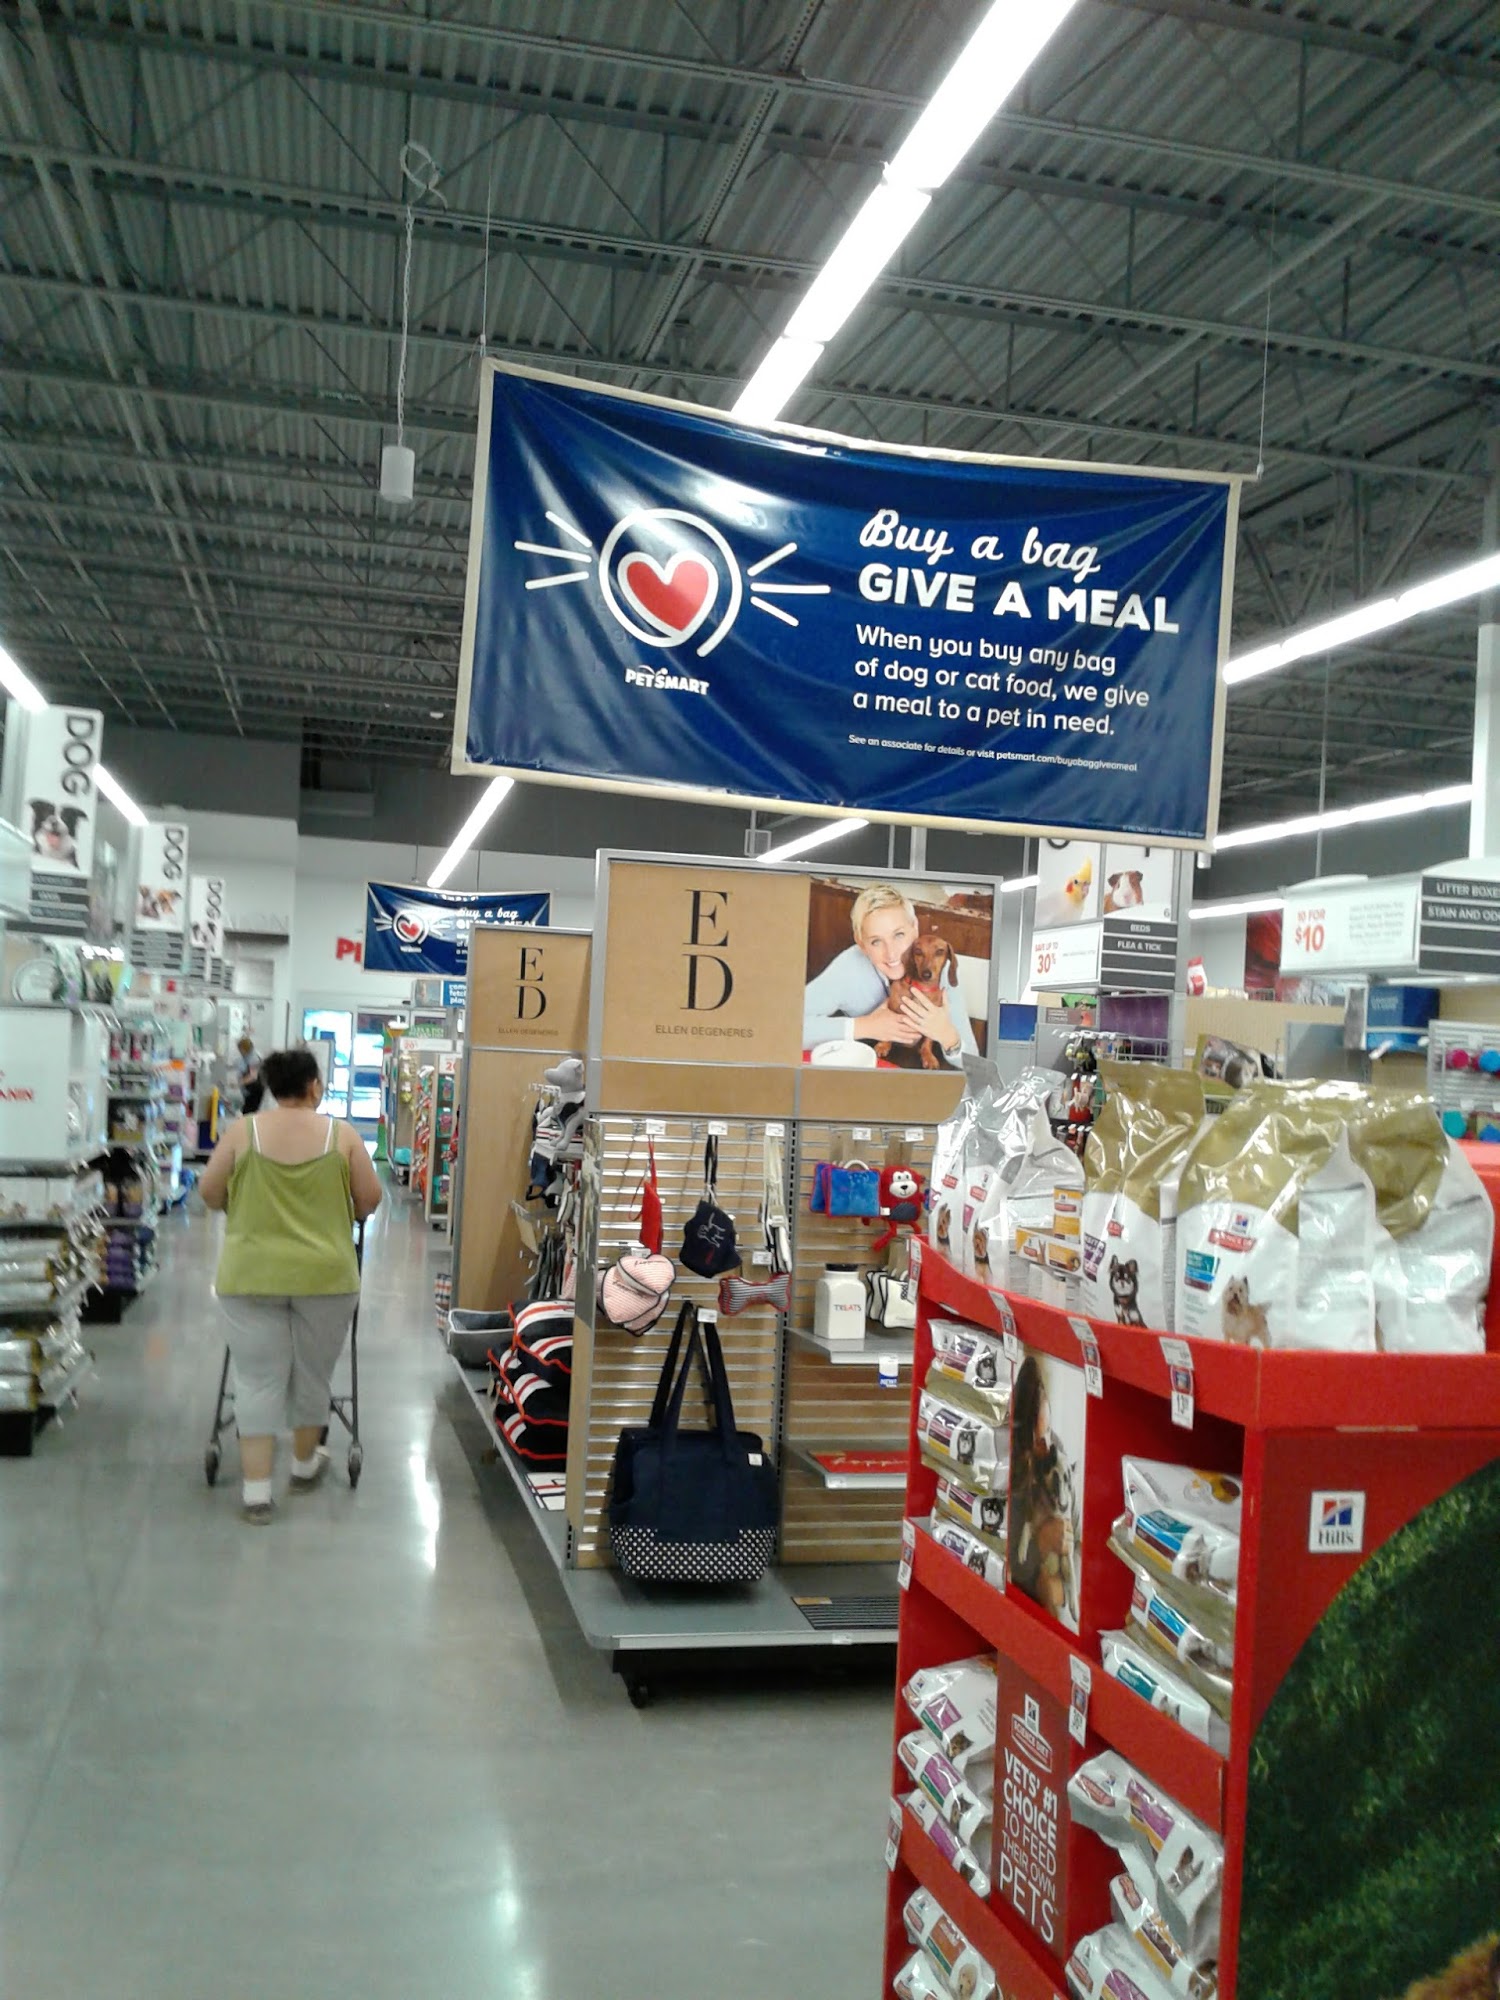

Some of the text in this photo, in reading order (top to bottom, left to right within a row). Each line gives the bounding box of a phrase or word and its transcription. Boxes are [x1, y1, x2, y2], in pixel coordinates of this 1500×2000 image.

[859, 508, 1101, 584] Buy a bag
[858, 562, 1179, 634] GIVE A MEAL
[855, 623, 1116, 677] When you buy any bag
[624, 667, 710, 695] PETSMART
[854, 657, 1149, 708] of dog or cat food, we give
[853, 691, 1115, 736] a meal to a pet in need.
[61, 714, 97, 796] DOG
[848, 734, 866, 744] See
[868, 737, 879, 746] an
[881, 738, 923, 751] associate
[924, 743, 936, 752] for
[937, 745, 965, 756] details
[966, 749, 975, 757] or
[976, 750, 995, 759] visit
[163, 827, 185, 880] DOG
[206, 879, 223, 920] DOG
[1436, 882, 1470, 896] LITTER
[484, 910, 493, 918] a
[497, 908, 519, 920] bag
[682, 889, 729, 947] E
[1130, 923, 1151, 933] BEDS
[1308, 909, 1325, 921] FOR
[1428, 905, 1457, 919] STAIN
[1458, 907, 1481, 920] AND
[515, 947, 544, 982] E
[1117, 940, 1162, 952] FLEA & TICK
[513, 984, 548, 1020] D
[680, 953, 733, 1011] D
[655, 1024, 754, 1038] ELLEN DEGENERES
[834, 1304, 862, 1312] TREATS
[1004, 1746, 1058, 1818] VETS' #1
[1003, 1777, 1058, 1850] CHOICE
[1003, 1803, 1057, 1876] TO FEED
[1002, 1829, 1056, 1902] THEIR OWN
